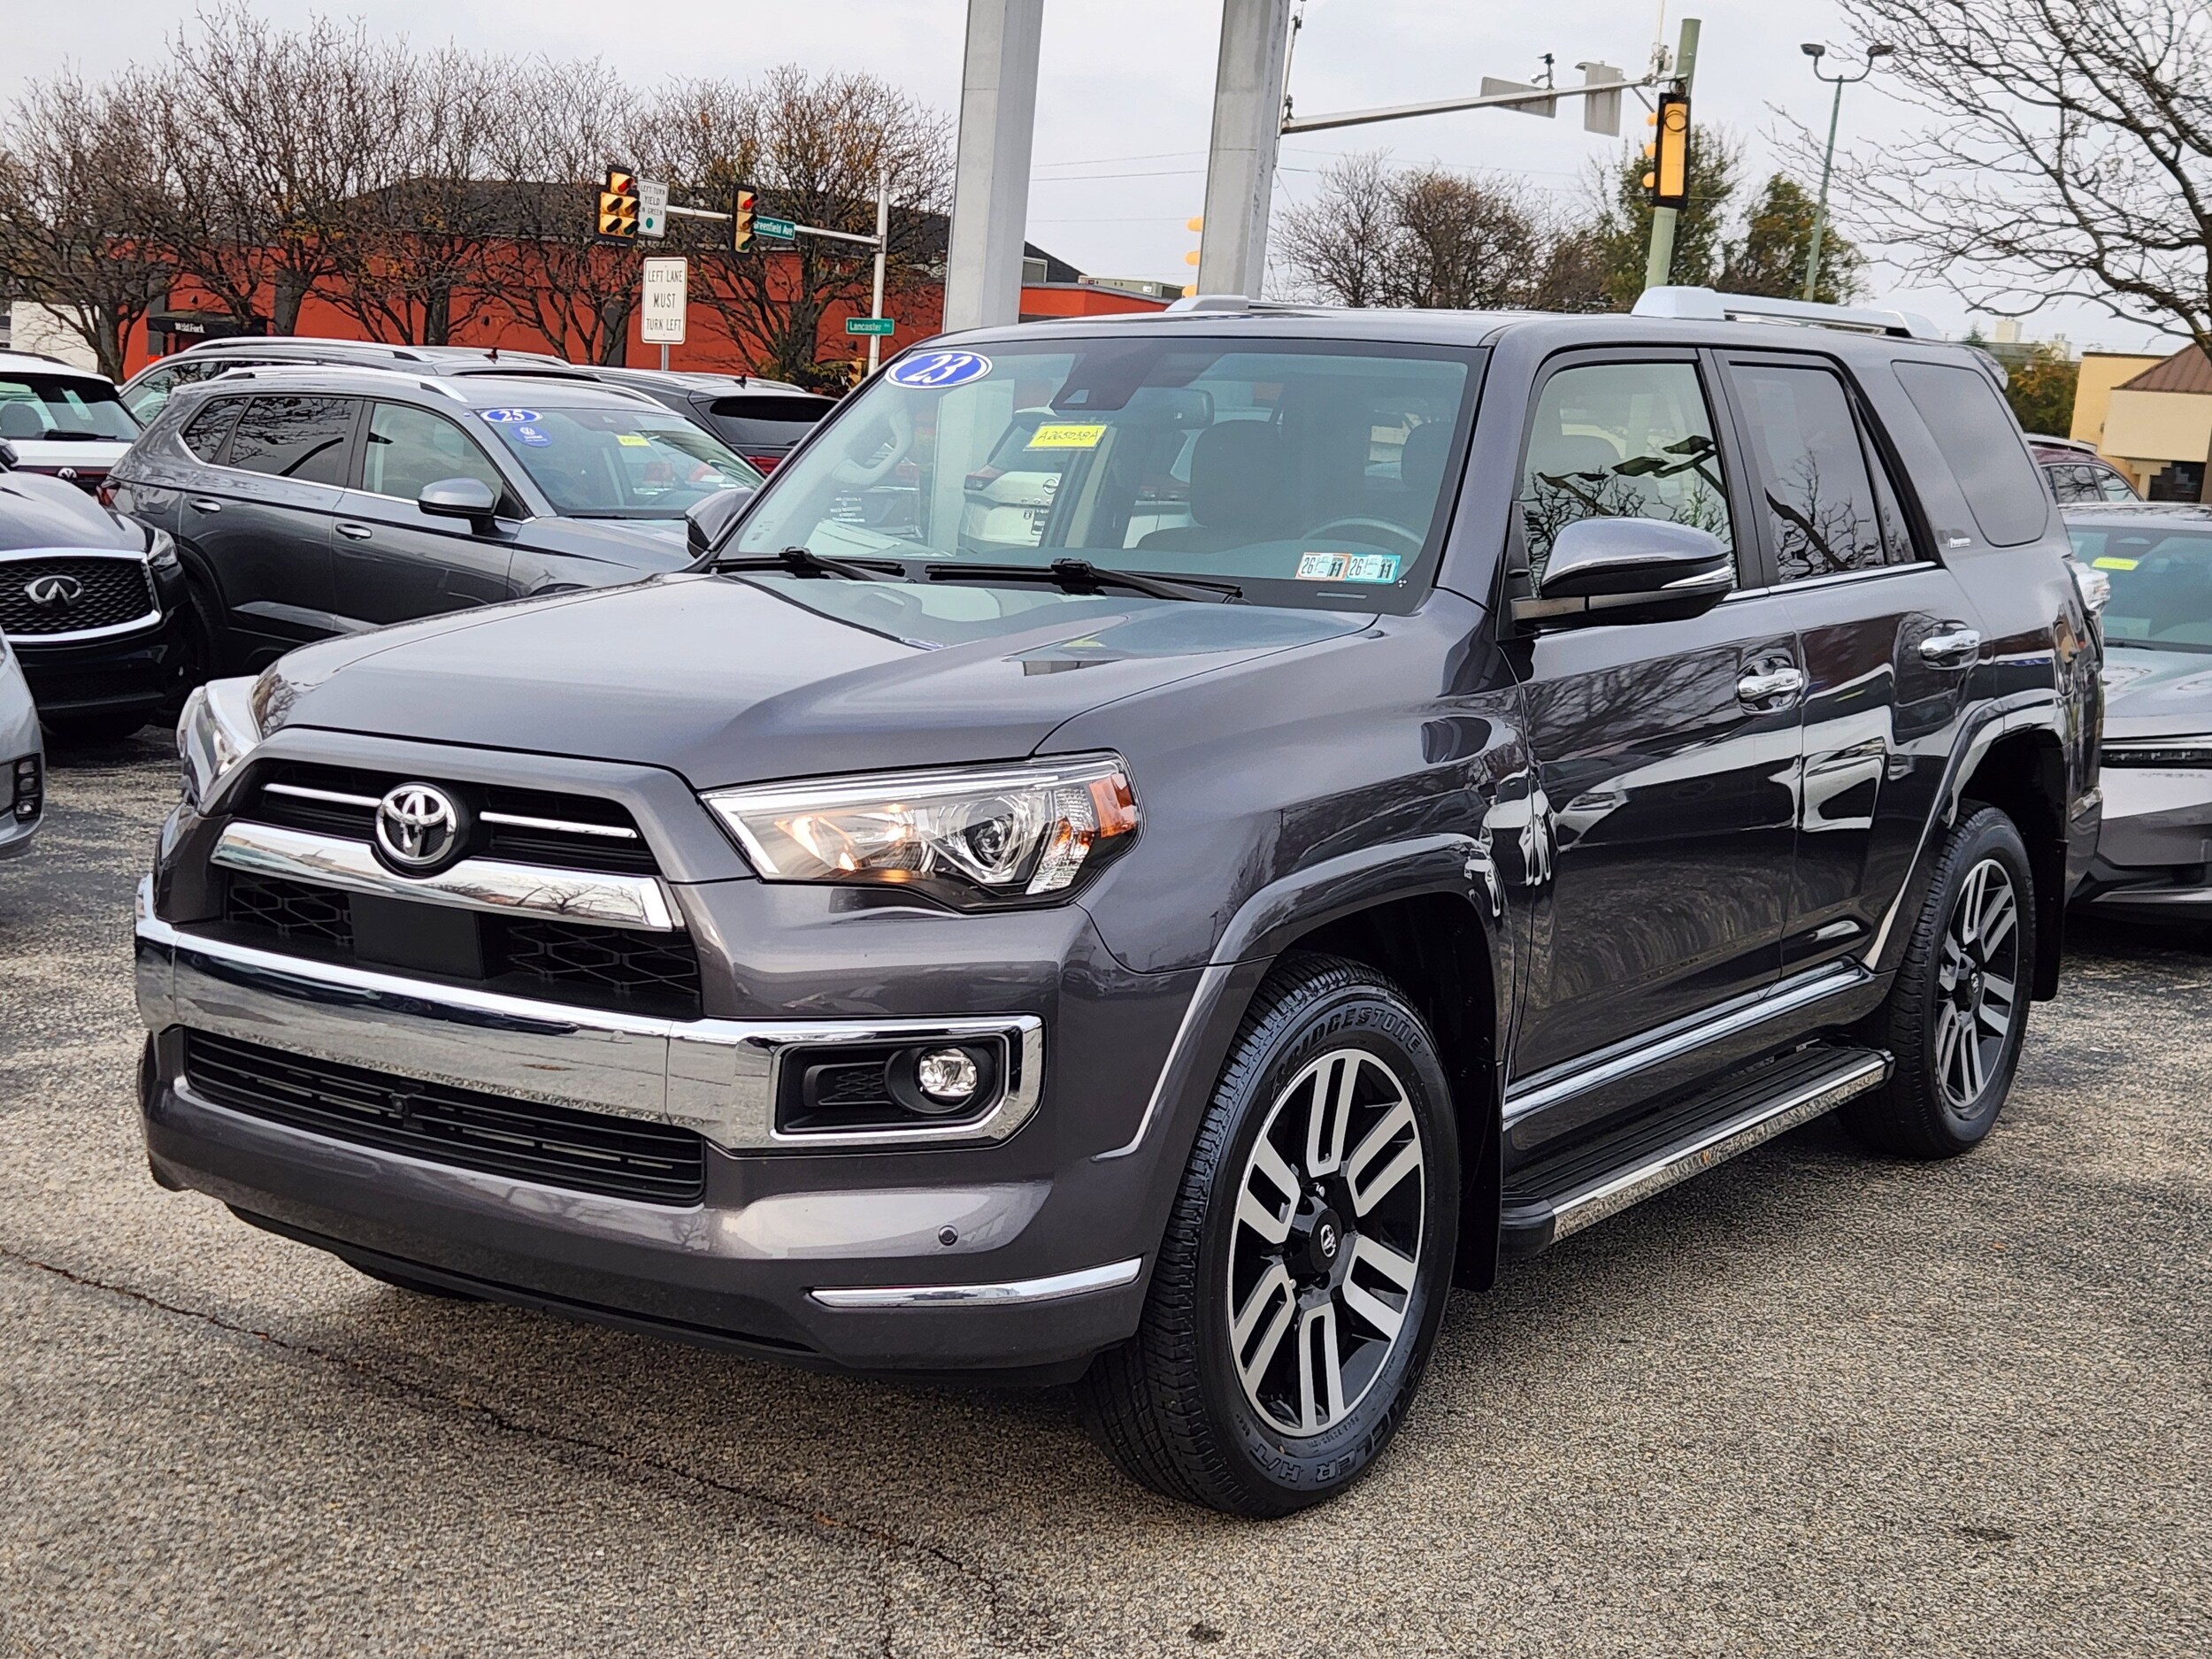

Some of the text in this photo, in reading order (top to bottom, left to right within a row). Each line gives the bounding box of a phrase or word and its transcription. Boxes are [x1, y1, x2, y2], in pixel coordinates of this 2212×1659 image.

[654, 187, 665, 196] TURN
[644, 196, 660, 205] YIELD
[783, 224, 794, 236] Ave
[648, 270, 683, 282] LEFT LANE
[653, 293, 676, 309] MUST
[647, 318, 681, 331] TURN LEFT
[849, 320, 881, 331] Lancaster
[902, 354, 973, 384] 23
[498, 409, 526, 421] 25
[1301, 557, 1344, 577] 26 11
[1349, 558, 1393, 579] 26 11
[1249, 1443, 1302, 1484] H/T
